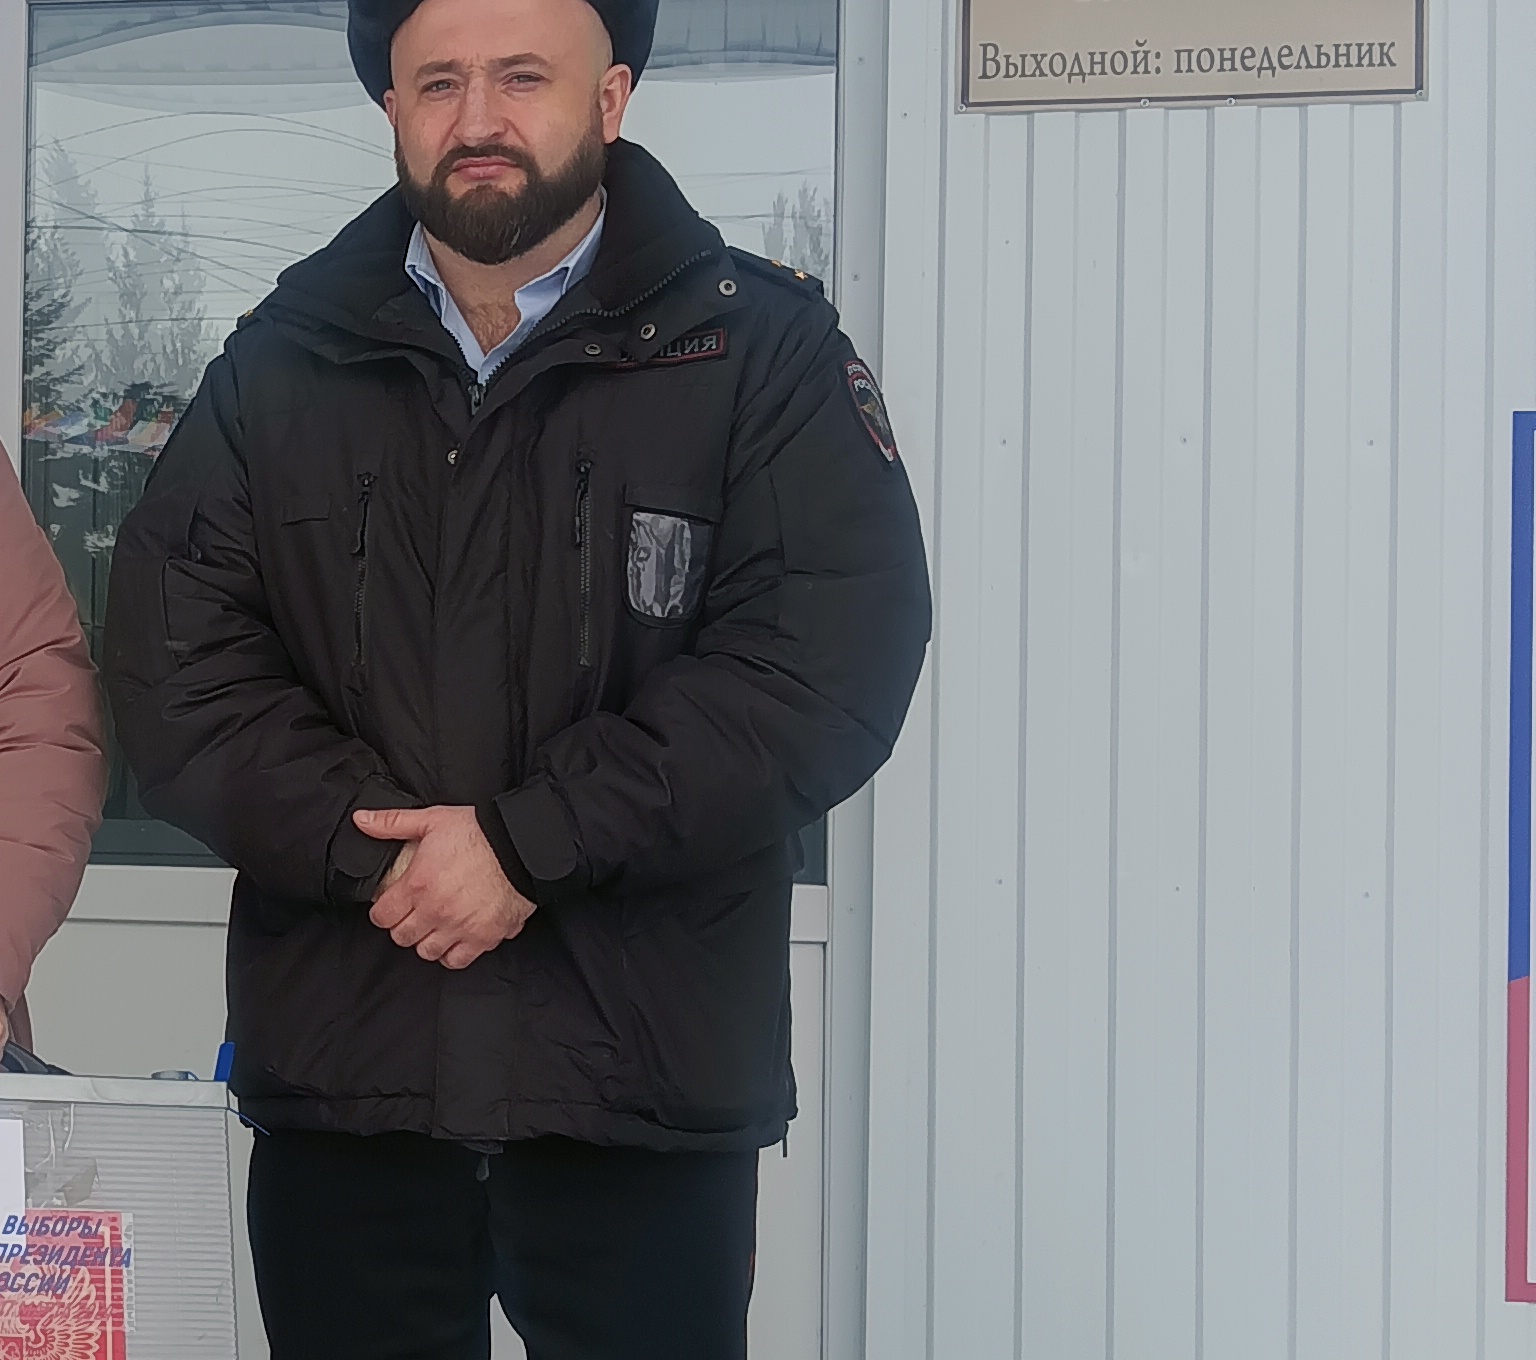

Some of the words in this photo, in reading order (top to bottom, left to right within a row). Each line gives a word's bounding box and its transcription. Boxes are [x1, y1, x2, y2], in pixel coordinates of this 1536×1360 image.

[977, 39, 1163, 84] Выходной:
[1172, 39, 1398, 79] понедельник
[1, 1214, 104, 1239] ВЫБОРЫ
